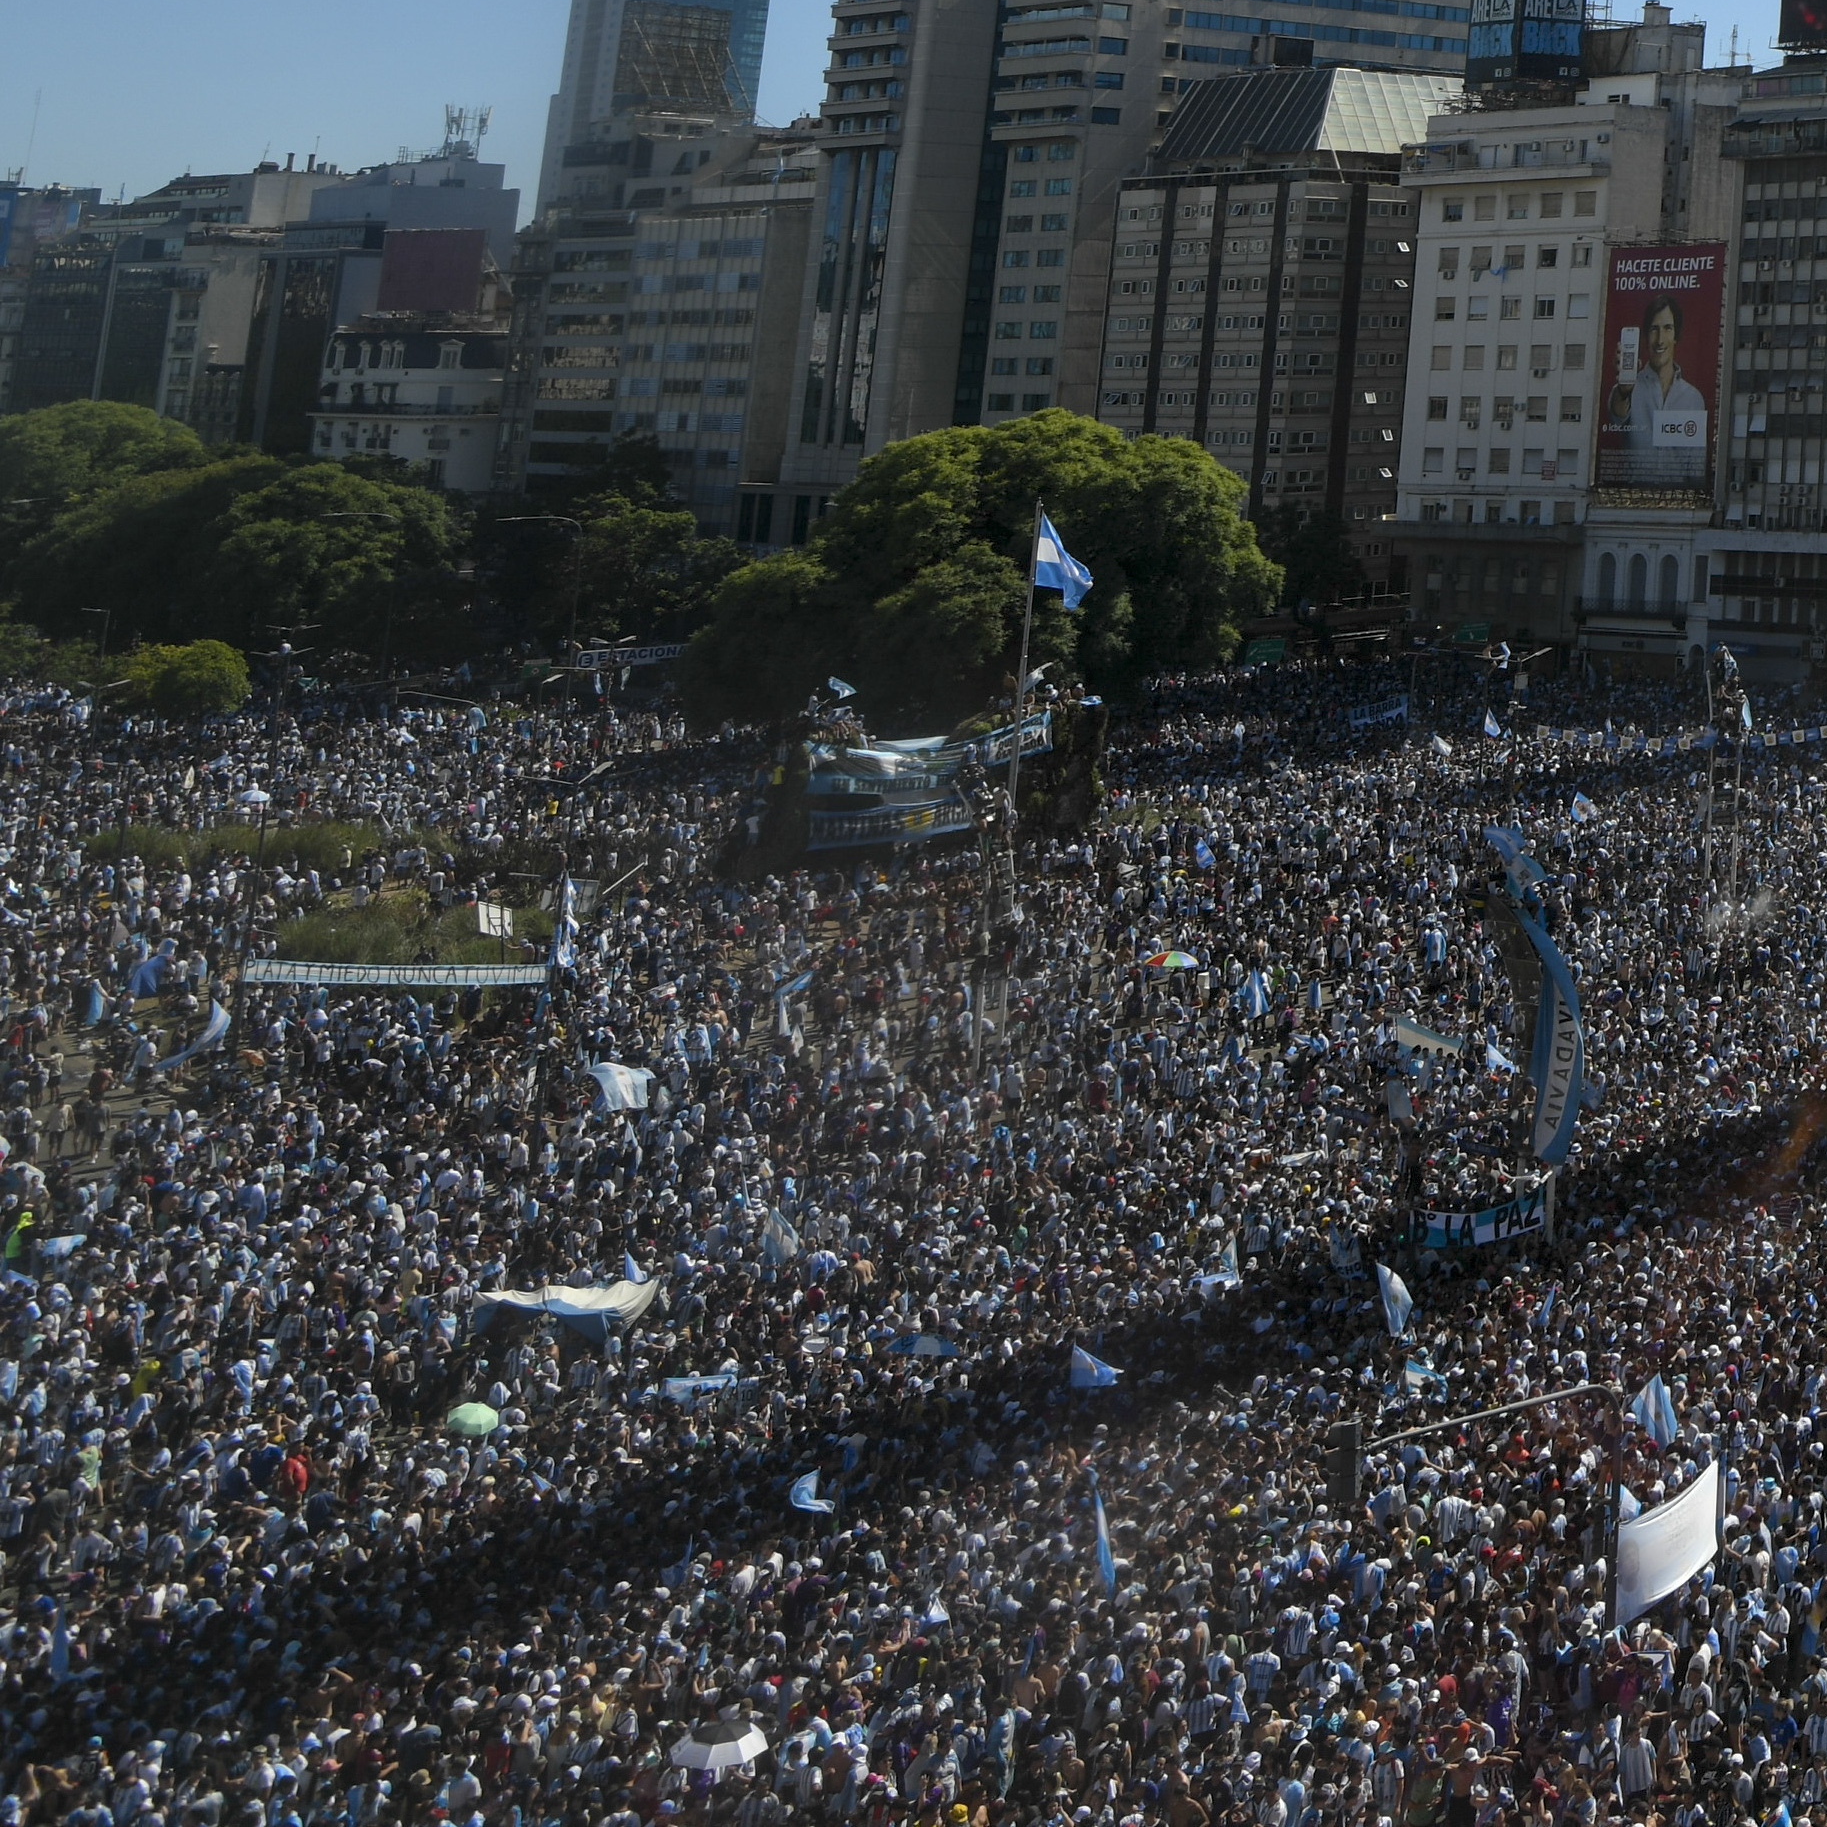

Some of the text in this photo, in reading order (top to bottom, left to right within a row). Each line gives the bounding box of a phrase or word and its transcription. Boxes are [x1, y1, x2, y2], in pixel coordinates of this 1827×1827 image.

[1468, 23, 1514, 59] BACK
[1521, 20, 1580, 56] BACK
[1616, 256, 1714, 273] HACETE CLIENTE
[1615, 275, 1700, 290] 100% ONLINE.
[1662, 423, 1683, 434] ICBC
[1354, 698, 1401, 720] LA BARRA
[245, 959, 298, 981] PLATA
[317, 964, 380, 983] MIEDO
[388, 966, 457, 984] NUNCA
[464, 966, 550, 984] TUVIMOS
[1444, 1215, 1475, 1246] LA
[1494, 1191, 1541, 1238] PAZ
